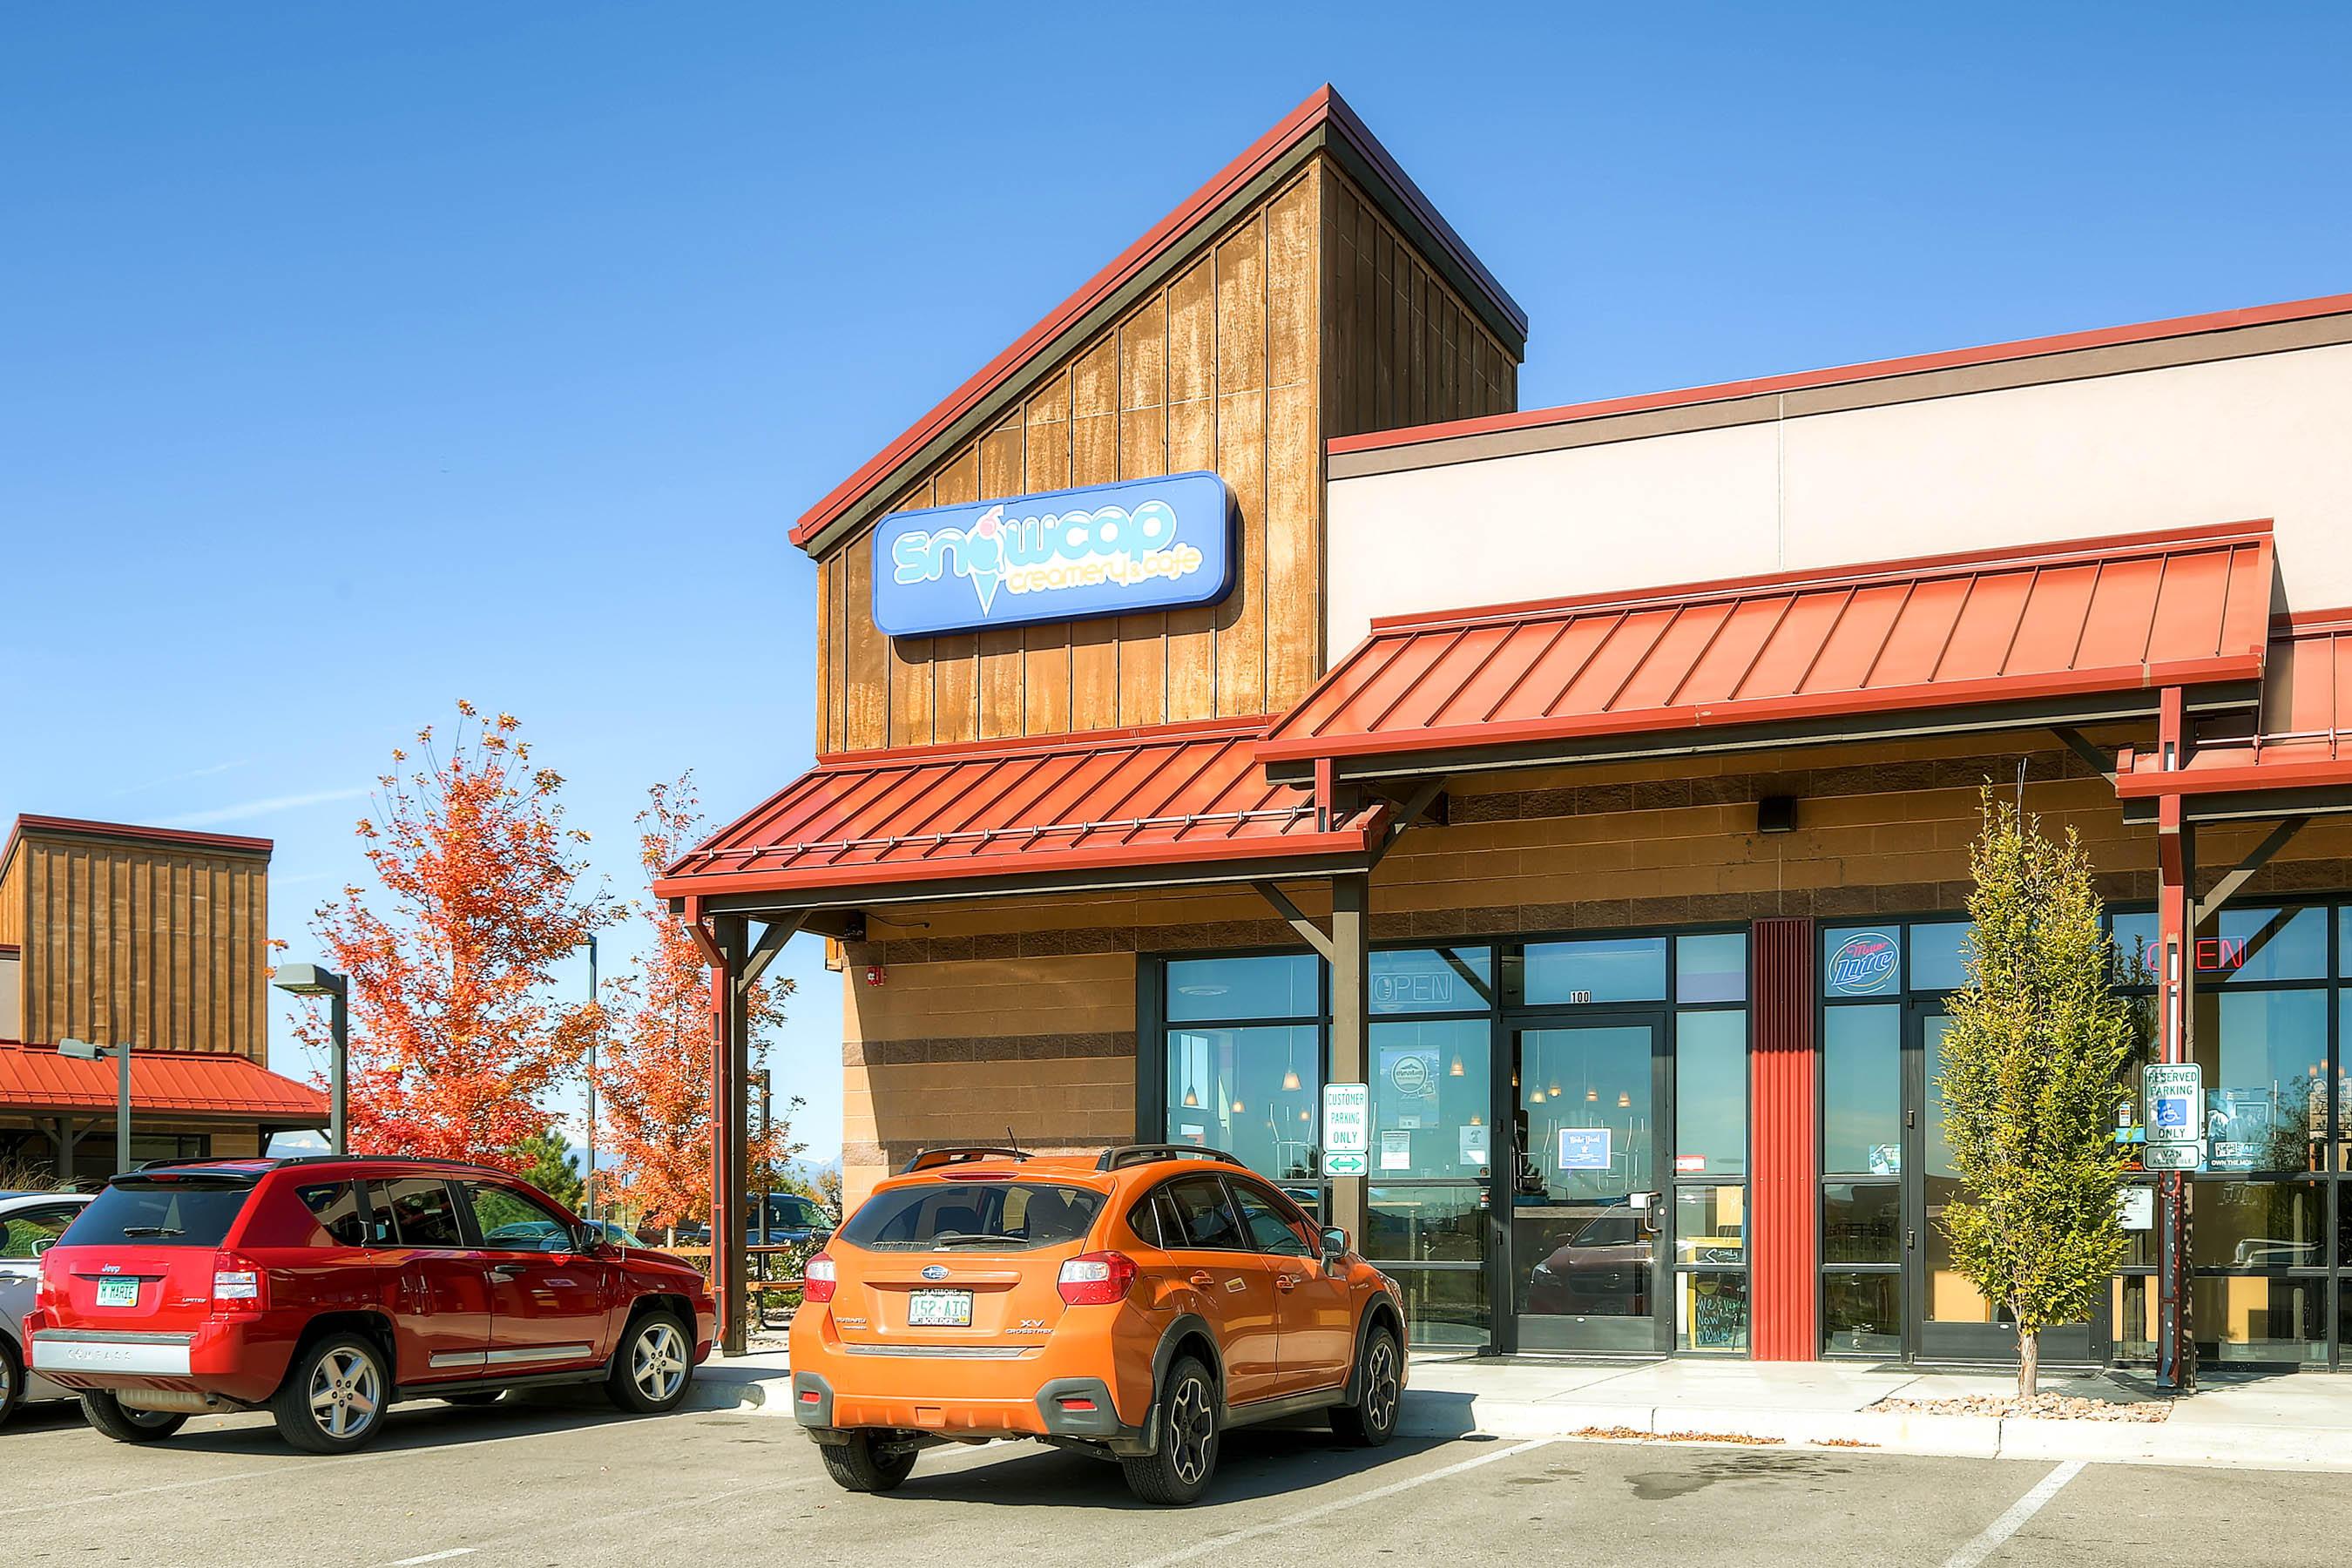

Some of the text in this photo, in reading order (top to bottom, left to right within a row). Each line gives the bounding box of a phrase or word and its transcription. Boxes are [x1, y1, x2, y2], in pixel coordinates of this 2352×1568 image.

[1009, 558, 1127, 591] creamery
[1143, 545, 1200, 577] cafe
[1831, 950, 1894, 986] Lite
[1375, 975, 1450, 1001] OPEN
[1571, 991, 1590, 1003] 100
[2148, 1072, 2197, 1082] RESERVED
[2150, 1085, 2193, 1096] PARKING
[1328, 1093, 1364, 1105] CUSTOMER
[1331, 1112, 1360, 1124] PARKING
[1334, 1132, 1358, 1144] ONLY
[2158, 1128, 2186, 1139] ONLY
[102, 1263, 121, 1274] Jeep
[101, 1286, 134, 1299] M MARIE
[913, 1300, 936, 1316] 152
[1020, 1319, 1044, 1328] XV
[1697, 1310, 1720, 1327] Now
[67, 1347, 132, 1360] COMPASS
